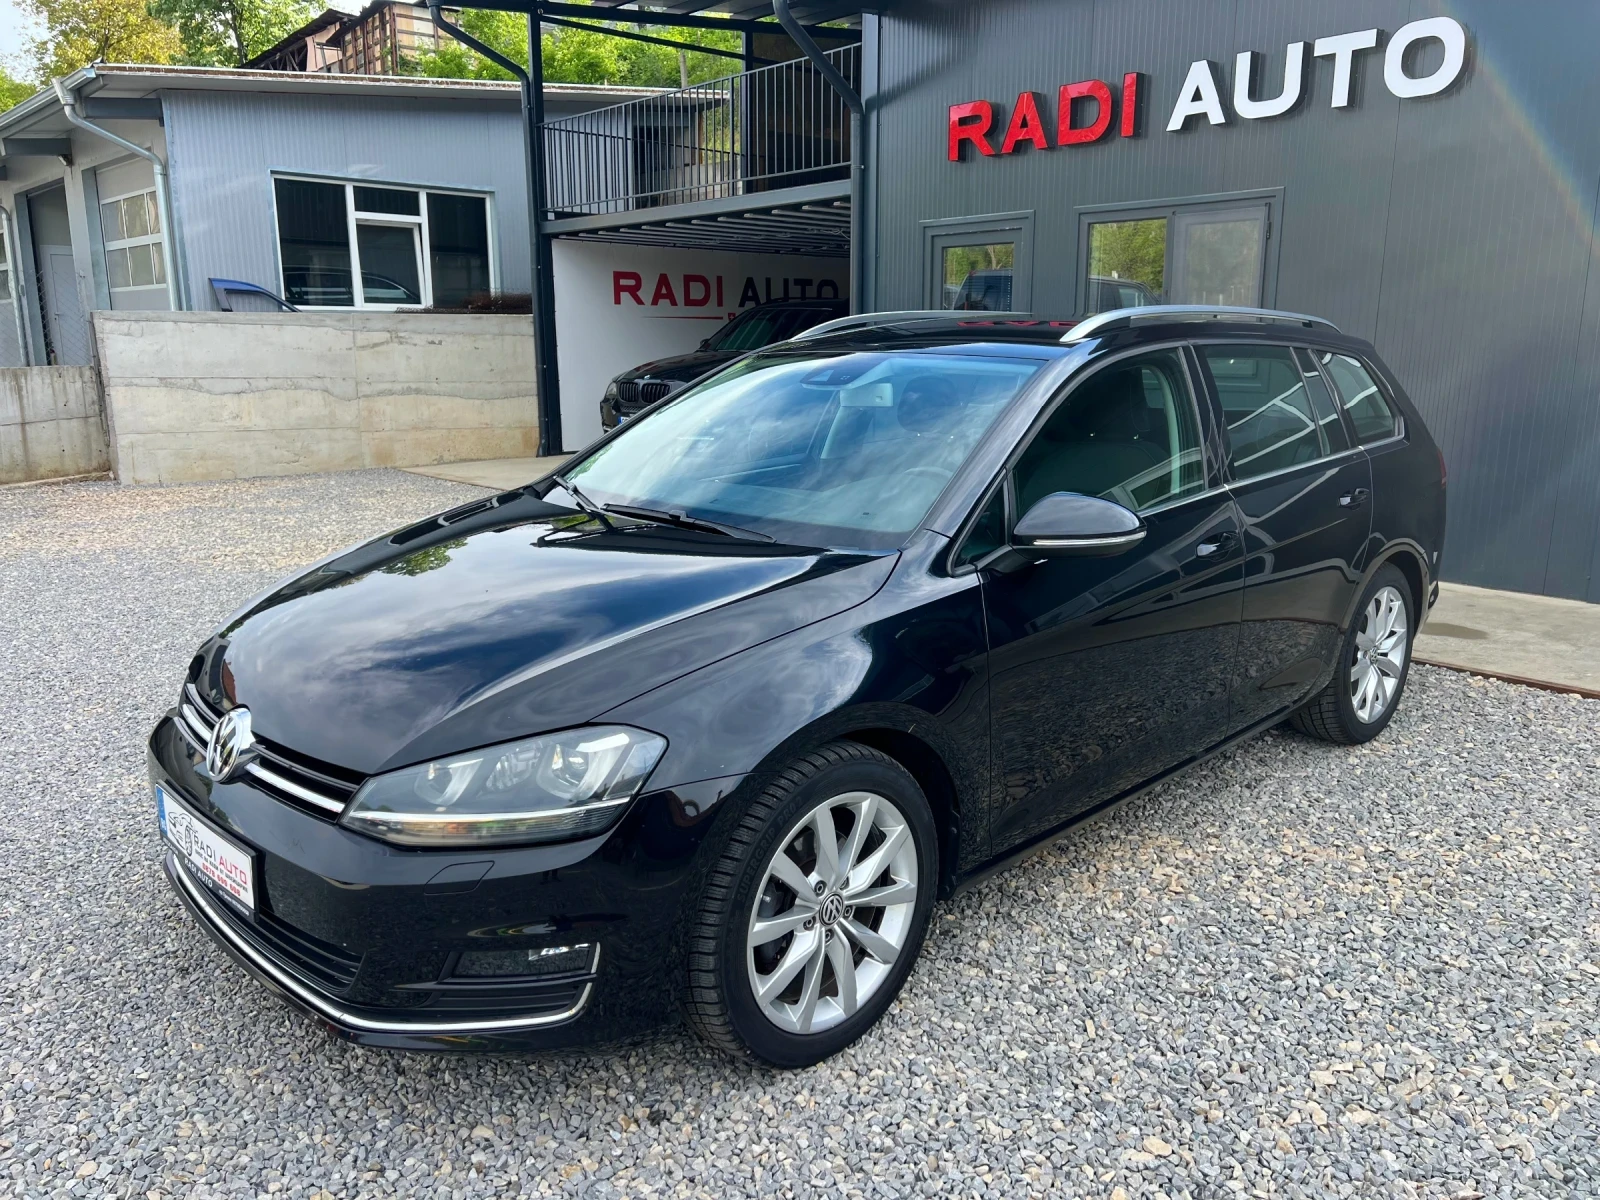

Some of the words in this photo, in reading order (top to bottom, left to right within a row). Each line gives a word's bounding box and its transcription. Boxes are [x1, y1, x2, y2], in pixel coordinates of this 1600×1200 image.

[948, 71, 1141, 162] RADI
[1166, 16, 1467, 132] AUTO
[613, 270, 724, 308] RADI
[738, 276, 840, 308] AUTO
[184, 857, 197, 874] RADI
[197, 870, 213, 888] AUTO
[194, 834, 216, 862] RADI
[219, 855, 247, 885] AUTO
[737, 827, 775, 903] SUPERGRIP
